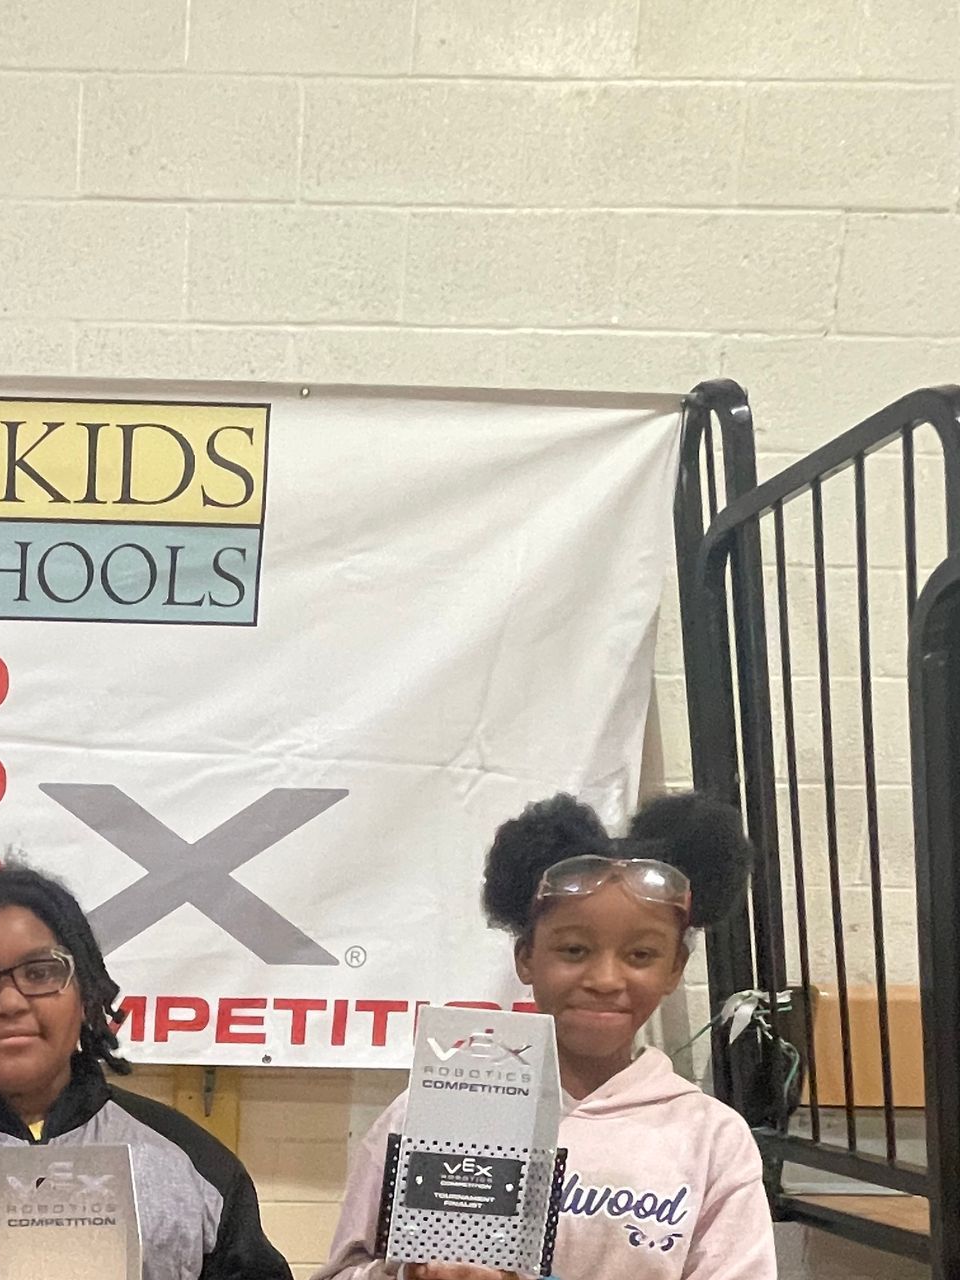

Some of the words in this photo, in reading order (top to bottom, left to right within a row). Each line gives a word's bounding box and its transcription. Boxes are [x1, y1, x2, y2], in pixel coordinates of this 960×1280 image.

[0, 420, 255, 509] KIDS
[427, 1029, 532, 1066] VEX
[424, 1066, 531, 1083] ROBOTICS
[422, 1080, 530, 1096] COMPETITION
[443, 1158, 493, 1177] VEX
[6, 1161, 116, 1199] VEX
[6, 1203, 117, 1214] ROBOTICS
[7, 1216, 117, 1228] COMPETITION
